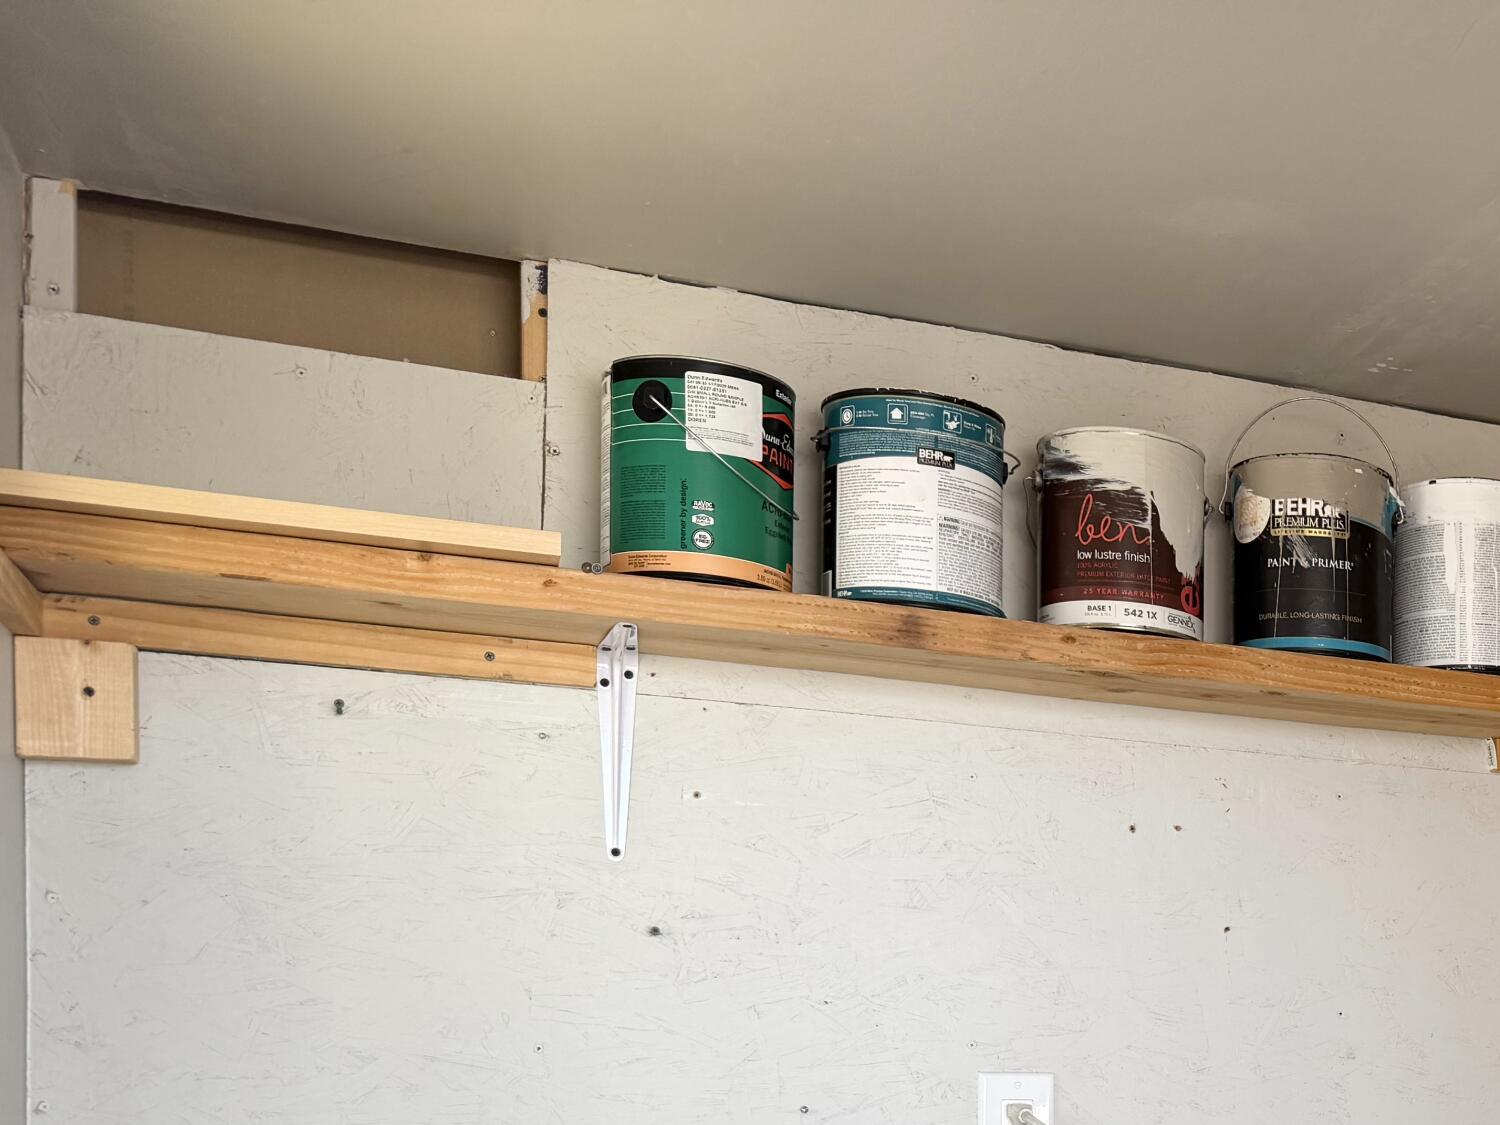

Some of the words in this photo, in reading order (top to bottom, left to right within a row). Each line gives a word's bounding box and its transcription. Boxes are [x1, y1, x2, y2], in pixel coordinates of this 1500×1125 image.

[919, 448, 943, 460] BEHR
[918, 458, 942, 467] PREMIUM
[1274, 498, 1324, 516] BEHR
[1075, 494, 1152, 545] ben
[1274, 517, 1319, 528] PREMIUM
[1077, 549, 1092, 560] low
[1095, 549, 1122, 560] lustre
[1124, 550, 1151, 563] finish
[1123, 608, 1143, 618] 542
[1146, 610, 1158, 620] 1X
